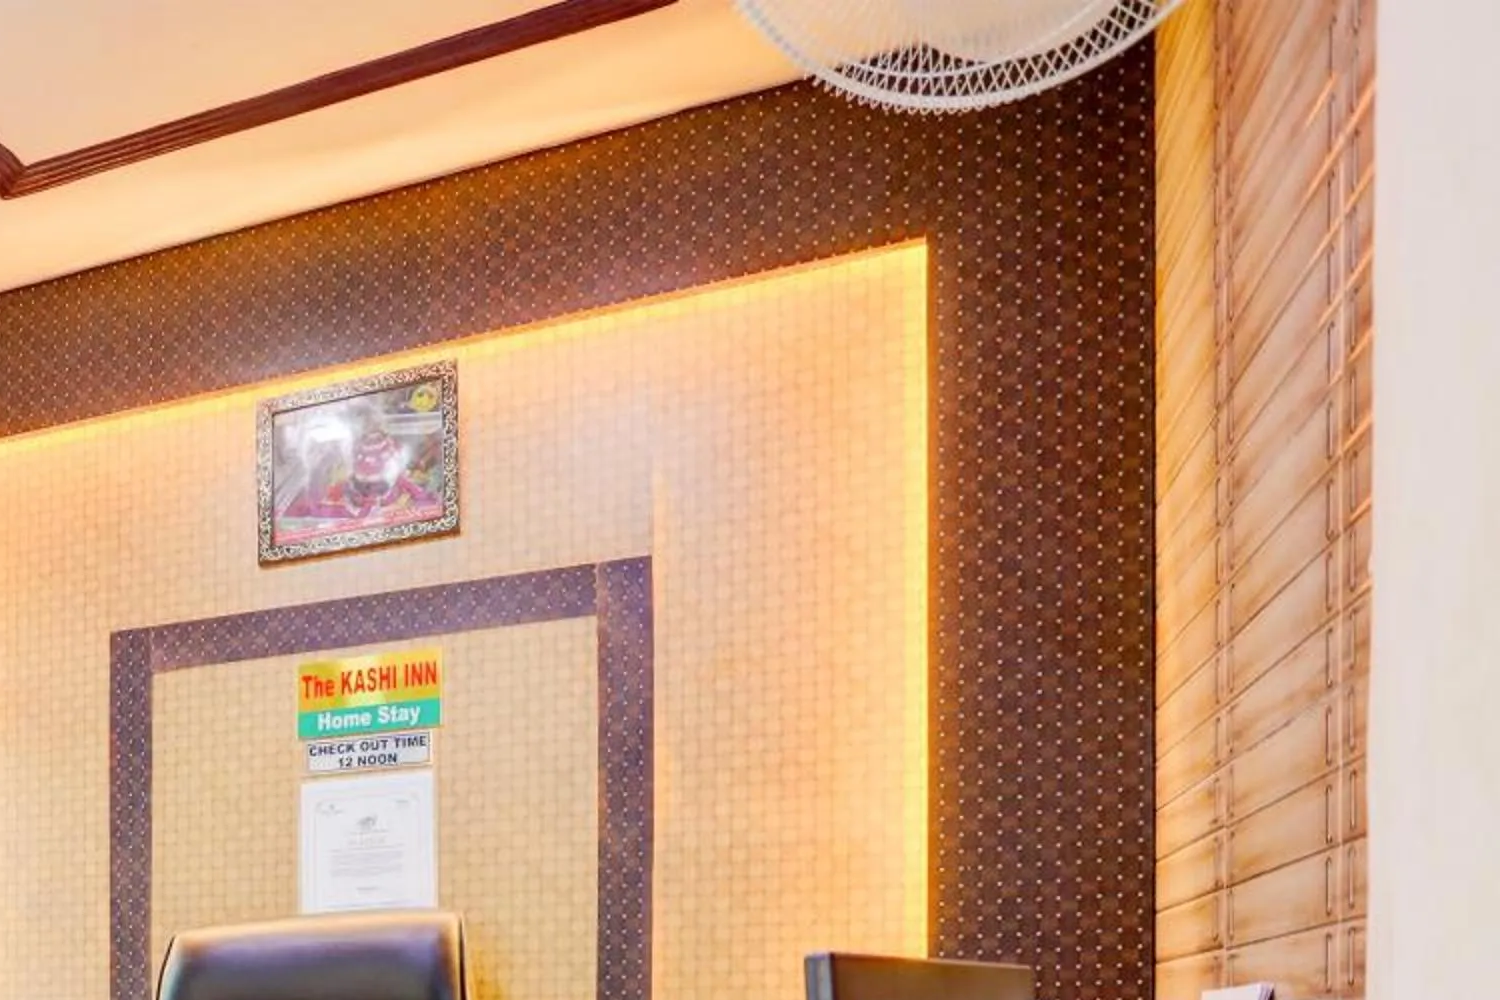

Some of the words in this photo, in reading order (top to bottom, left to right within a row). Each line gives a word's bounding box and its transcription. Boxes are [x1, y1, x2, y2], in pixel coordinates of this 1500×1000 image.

[301, 674, 335, 699] The
[340, 665, 397, 696] KASHI
[404, 661, 437, 688] INN
[317, 711, 372, 731] Home
[377, 705, 420, 725] Stay
[309, 742, 355, 757] CHECK
[359, 739, 389, 752] OUT
[394, 735, 427, 749] TIME
[339, 756, 353, 767] 12
[357, 753, 397, 766] NOON
